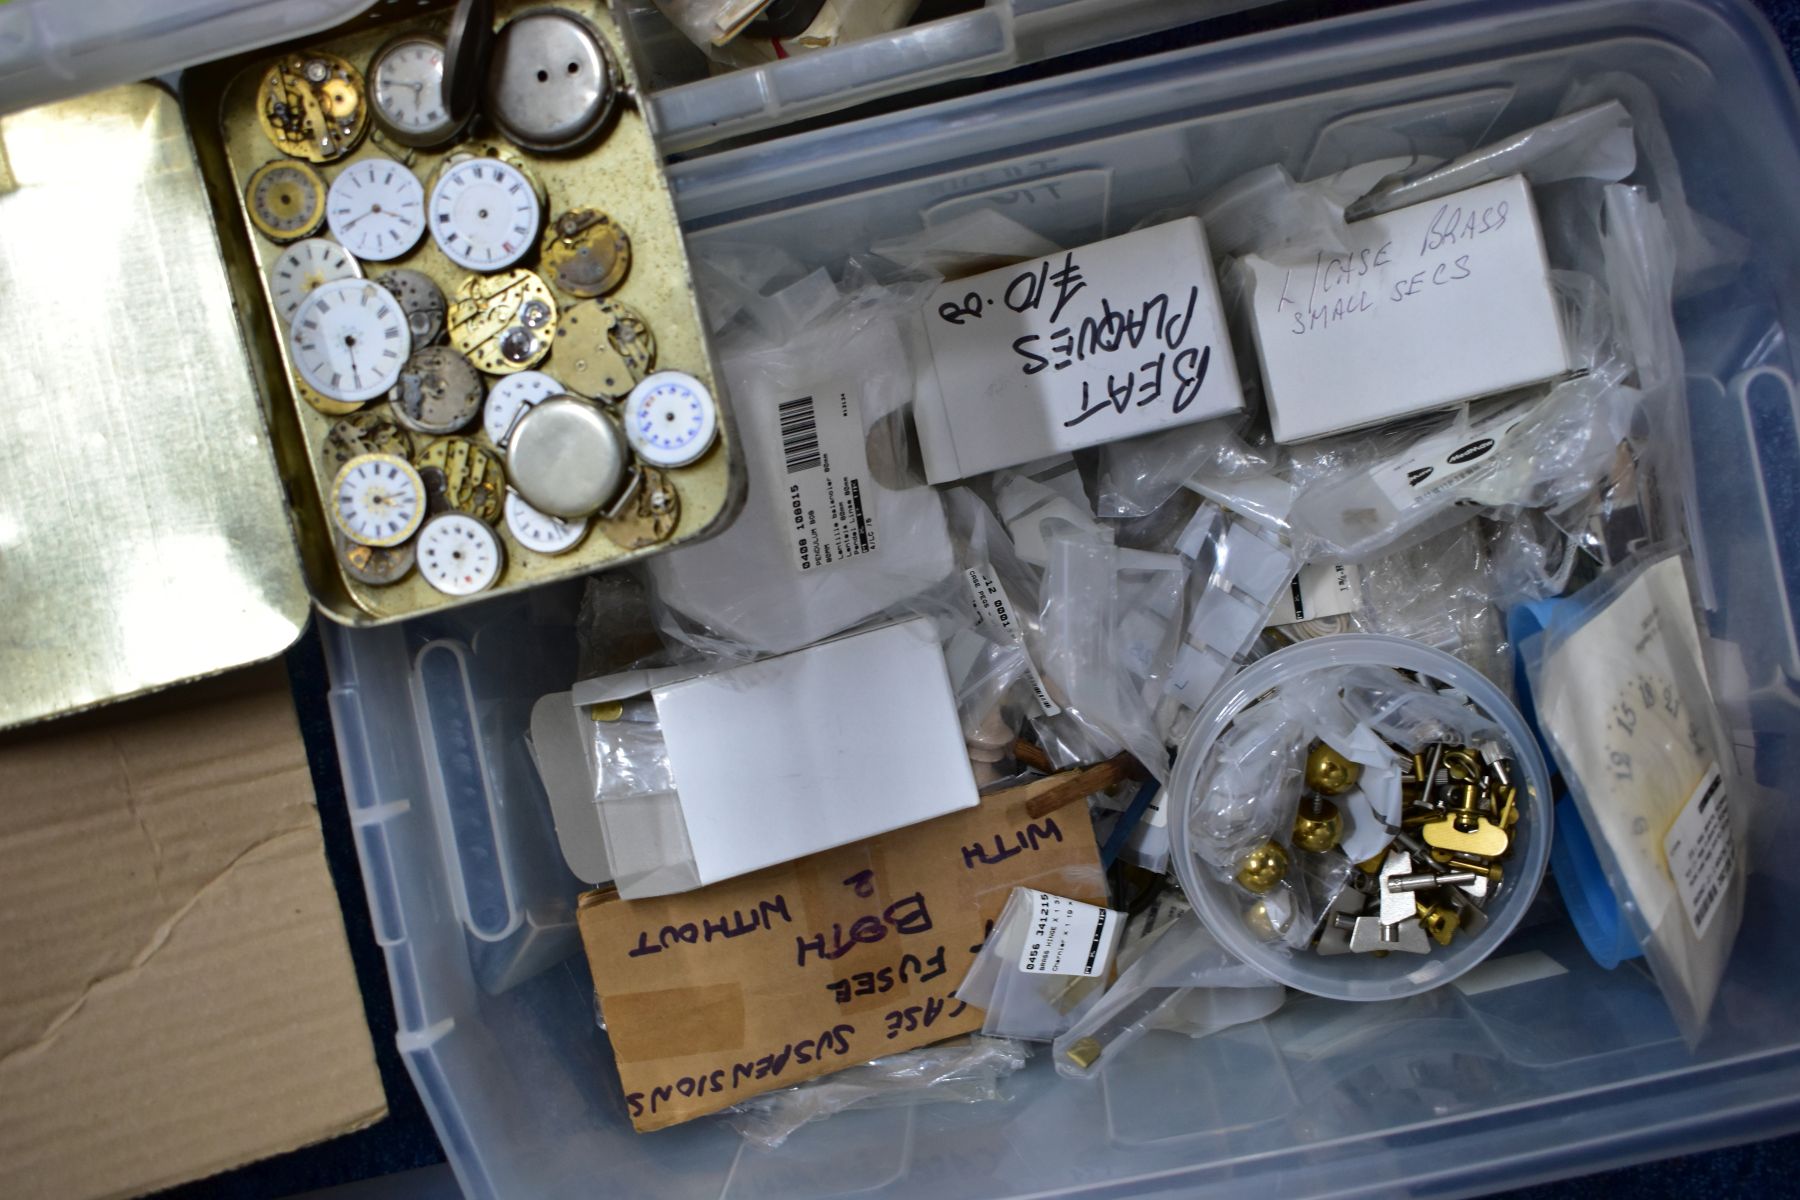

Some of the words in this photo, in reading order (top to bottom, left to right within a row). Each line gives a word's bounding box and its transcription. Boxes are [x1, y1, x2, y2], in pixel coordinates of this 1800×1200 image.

[1420, 205, 1508, 256] BRASS
[1292, 292, 1371, 335] SMALL
[1391, 255, 1471, 302] SECS
[1012, 287, 1198, 374] PLAQUES
[1064, 346, 1210, 427] BEAT
[810, 528, 822, 566] PENDULUM
[969, 571, 981, 588] CASE
[962, 817, 1063, 868] WITH
[628, 894, 792, 958] WITHOUT
[798, 892, 932, 967] BOTH
[1026, 944, 1040, 970] 0456
[1036, 894, 1049, 936] 341215
[1046, 927, 1056, 947] HINGE
[826, 945, 946, 1003] FUSEE
[626, 1025, 855, 1118] SUSPENSIONS
